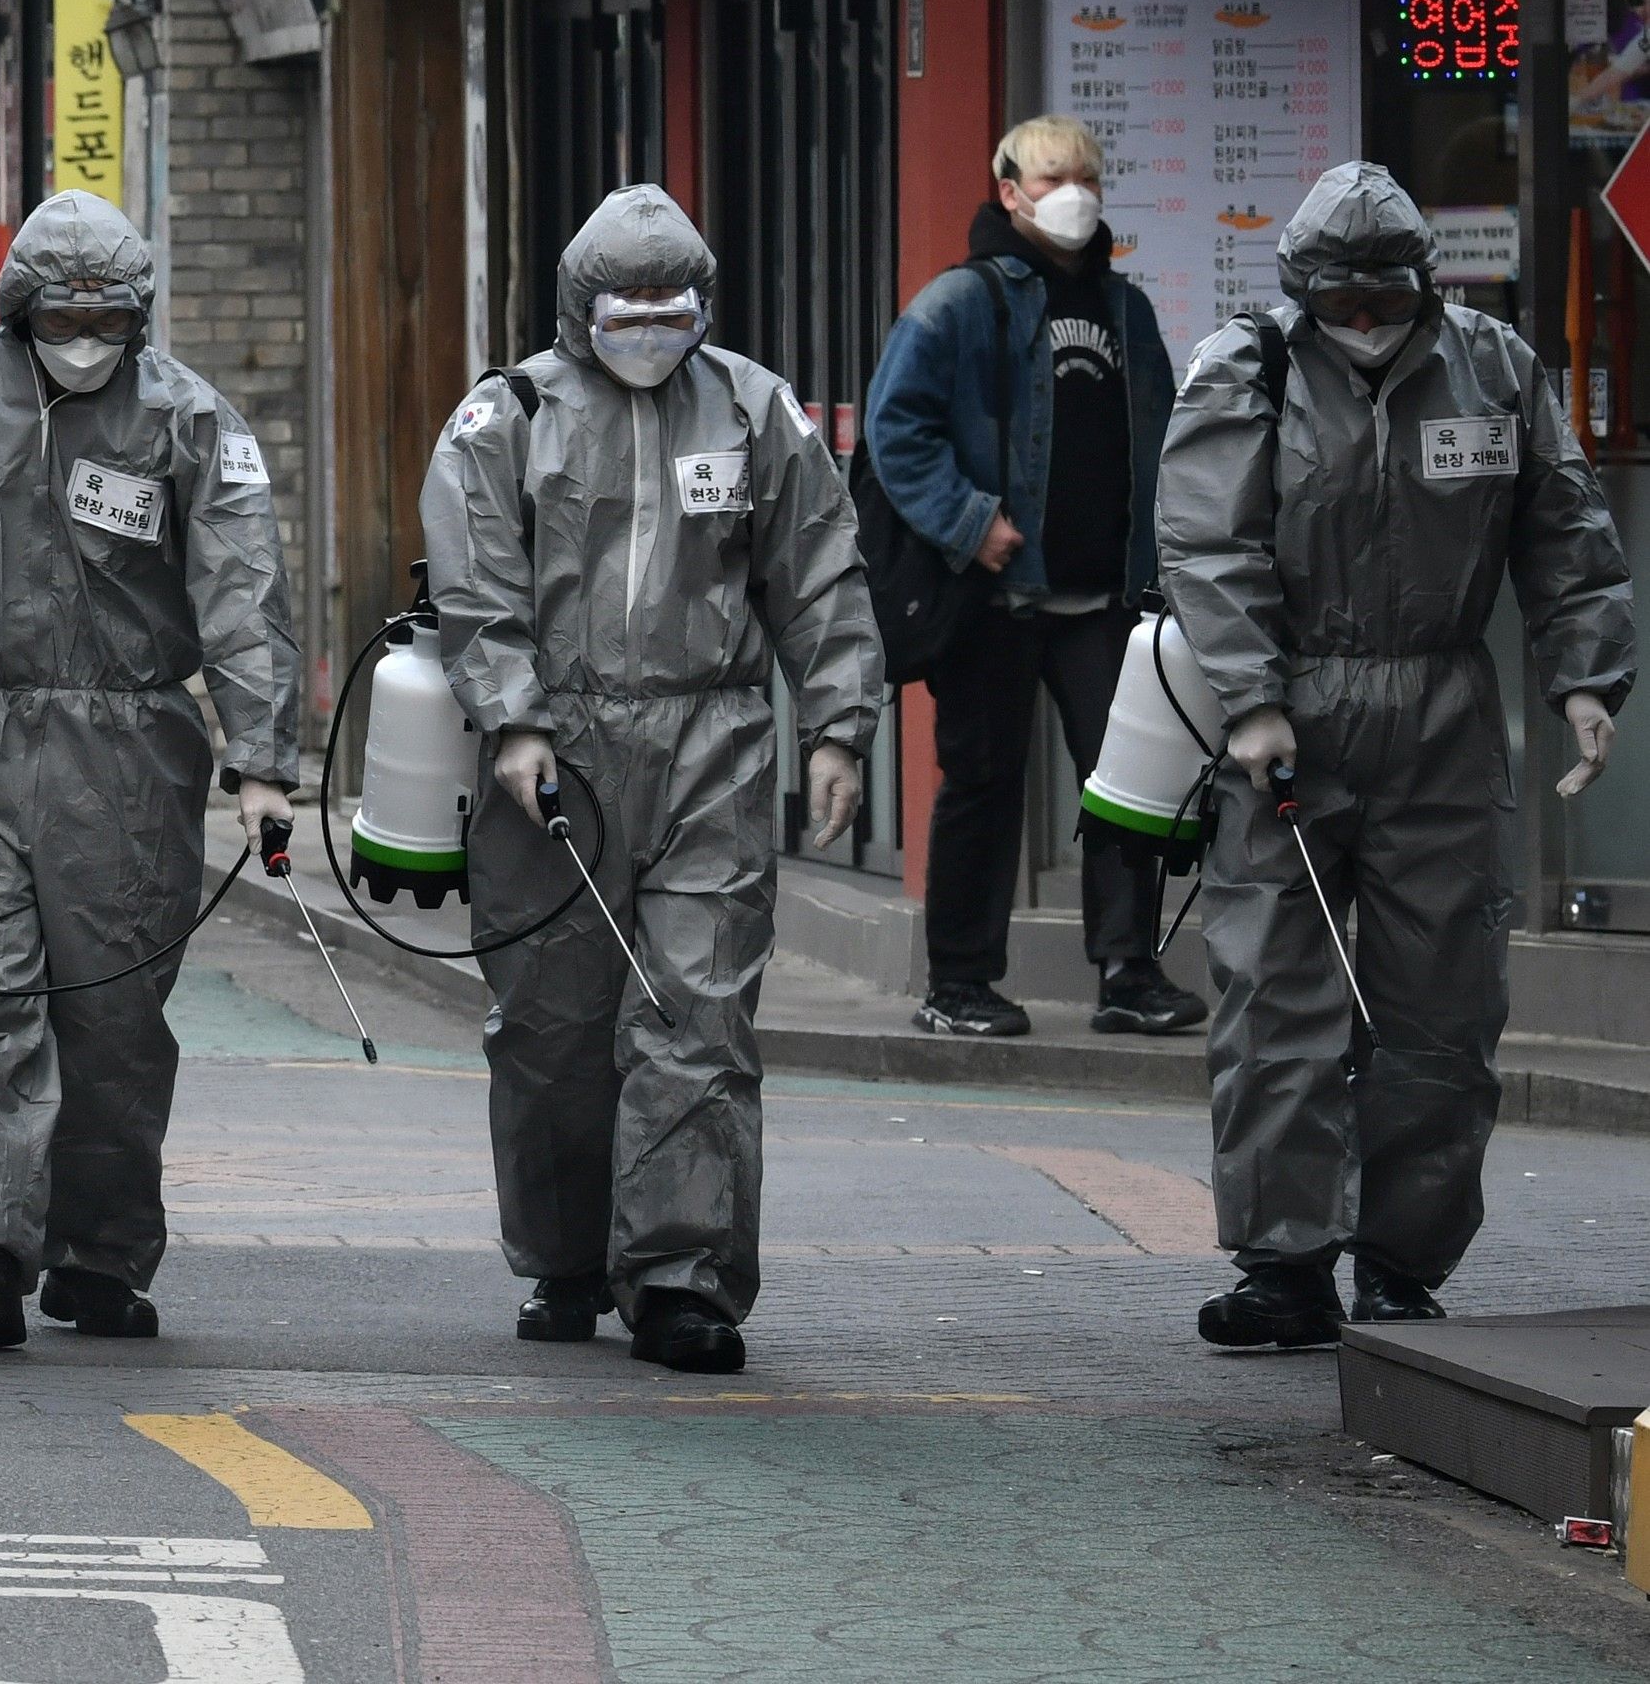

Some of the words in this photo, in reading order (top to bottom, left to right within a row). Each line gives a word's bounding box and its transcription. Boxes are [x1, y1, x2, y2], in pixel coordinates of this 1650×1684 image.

[1436, 429, 1458, 447] 육
[1432, 451, 1463, 469] 현장
[1469, 449, 1510, 466] 지원팀
[694, 463, 713, 481] 육
[85, 474, 103, 494] 육
[689, 486, 720, 502] 현장
[74, 493, 104, 515] 현장
[108, 505, 151, 530] 지원팀
